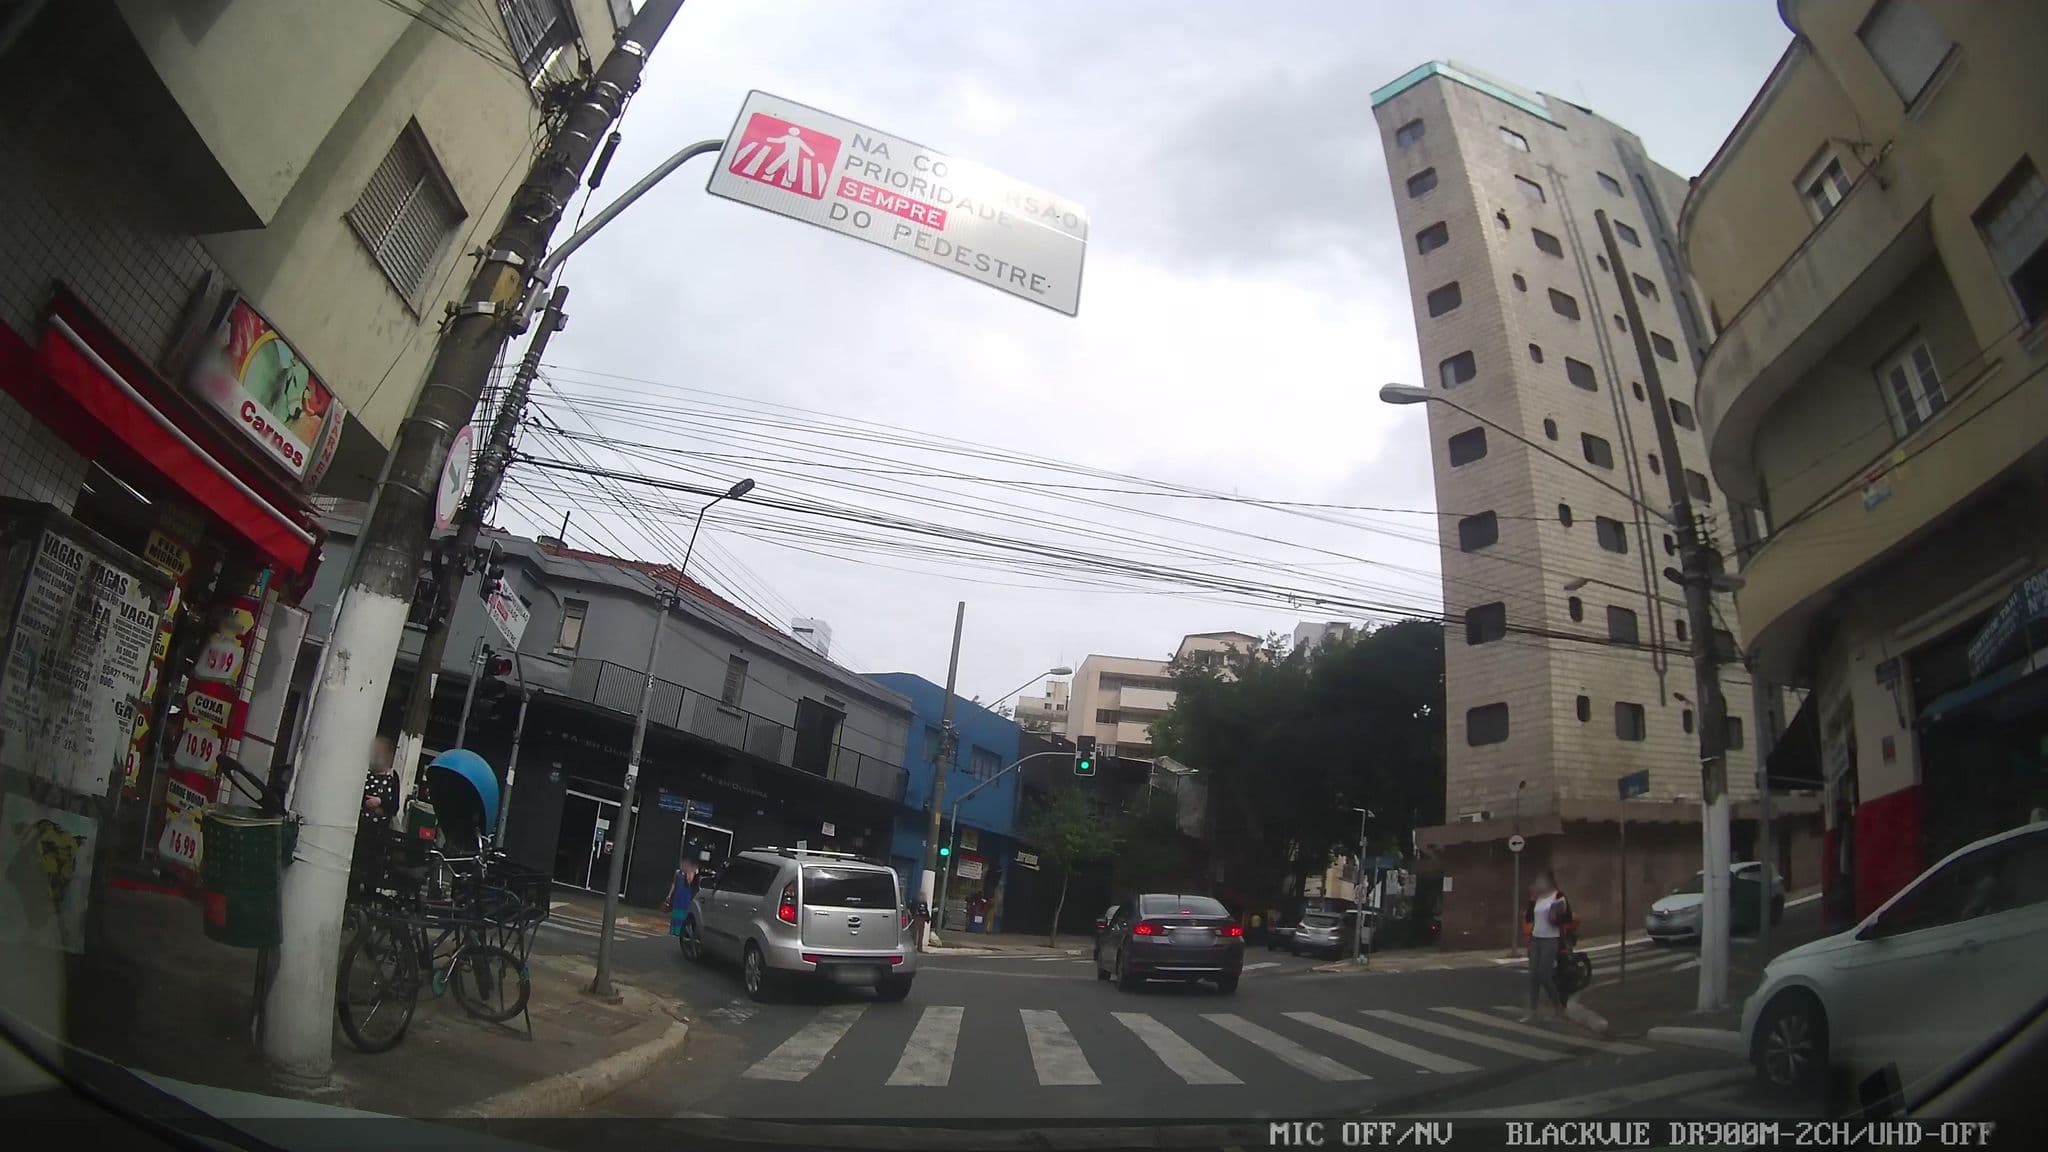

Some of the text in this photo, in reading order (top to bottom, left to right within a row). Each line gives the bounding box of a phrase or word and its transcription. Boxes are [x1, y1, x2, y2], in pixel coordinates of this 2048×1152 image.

[851, 133, 890, 160] NA
[842, 181, 943, 227] SEMPRE
[844, 154, 1015, 230] PRIORIDADE
[829, 203, 1046, 296] DO PEDESTRE
[240, 400, 304, 469] Carnes
[43, 533, 83, 572] VAGAS
[120, 602, 154, 630] VAGA
